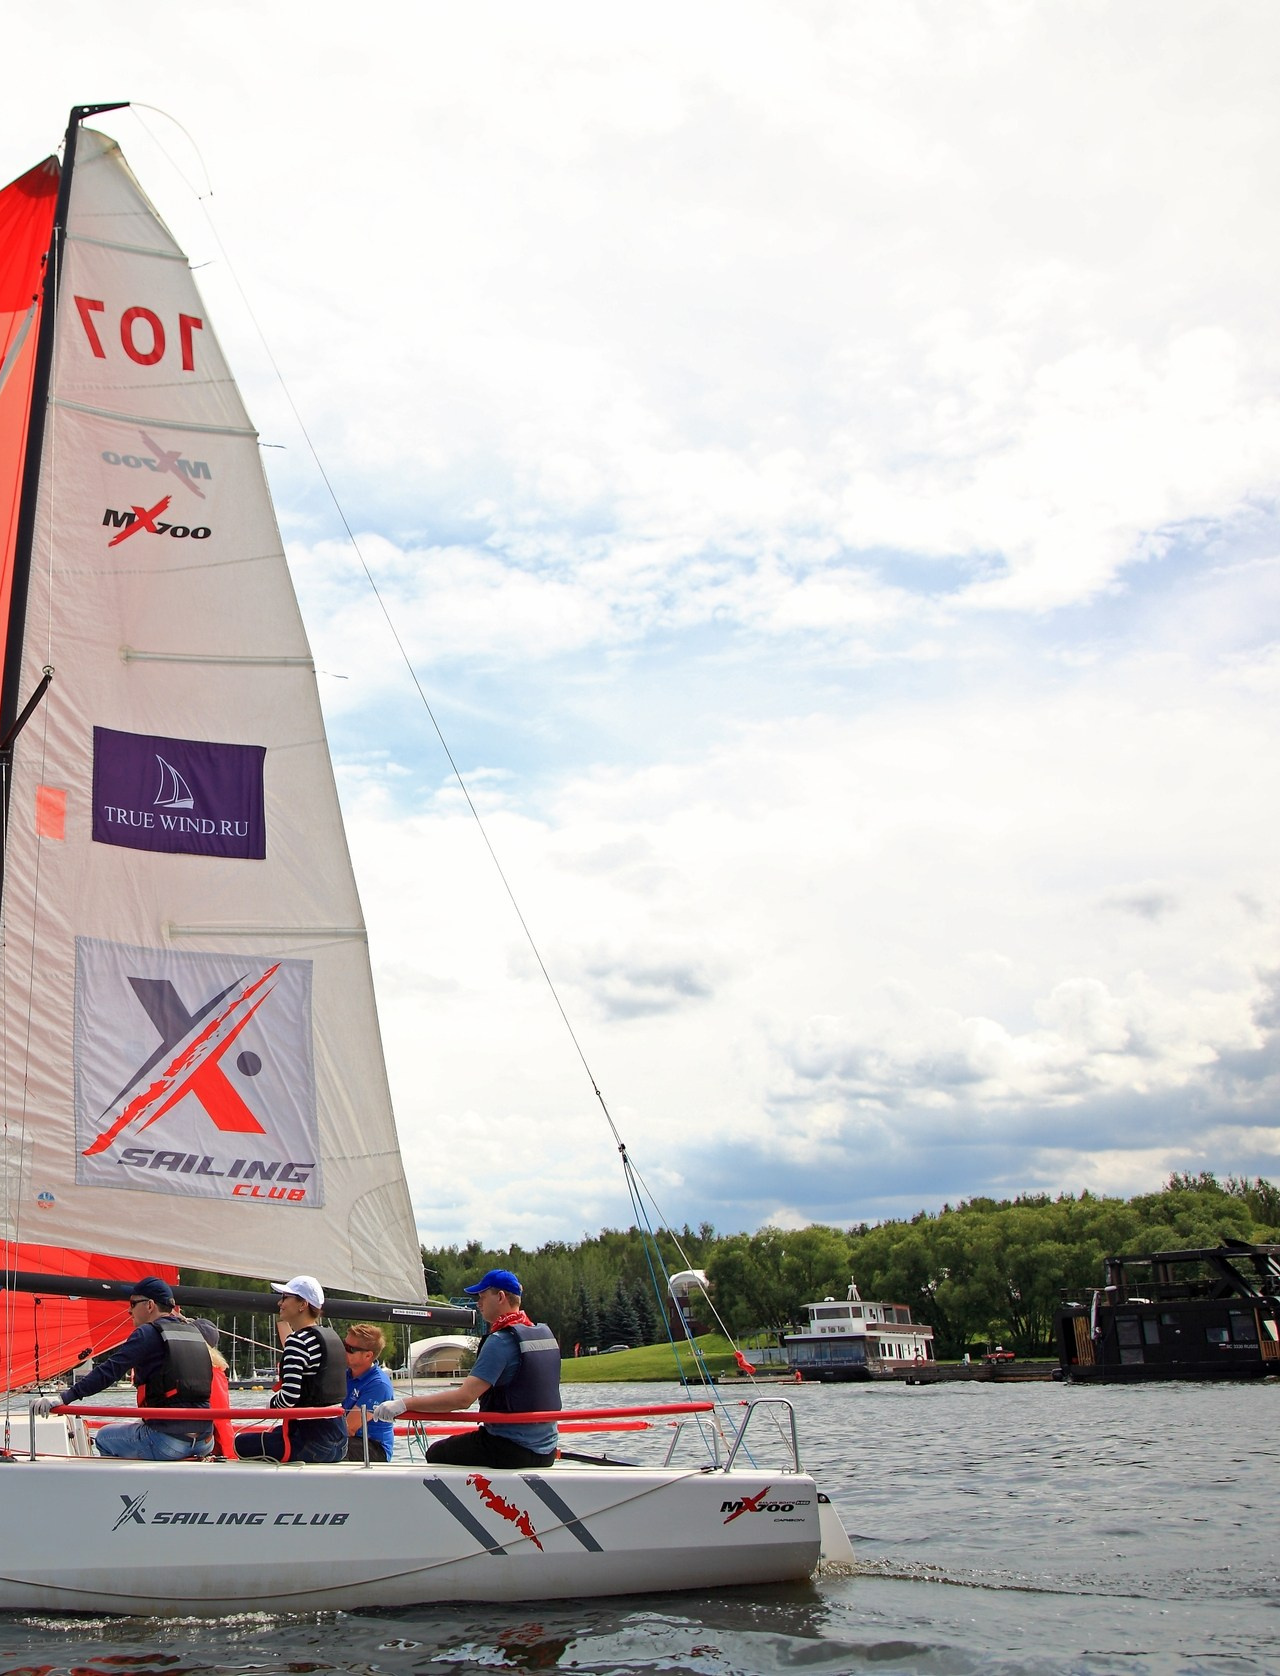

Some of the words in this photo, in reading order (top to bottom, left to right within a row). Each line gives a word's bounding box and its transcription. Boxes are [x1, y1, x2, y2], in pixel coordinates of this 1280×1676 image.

[102, 495, 212, 547] MX700
[104, 806, 155, 828] TRUE
[160, 814, 249, 837] WIND.RU
[117, 1147, 315, 1184] SAILING
[232, 1184, 306, 1202] CLUB
[151, 1512, 267, 1525] SAILING
[273, 1513, 350, 1526] CLUB
[720, 1486, 794, 1524] MX700
